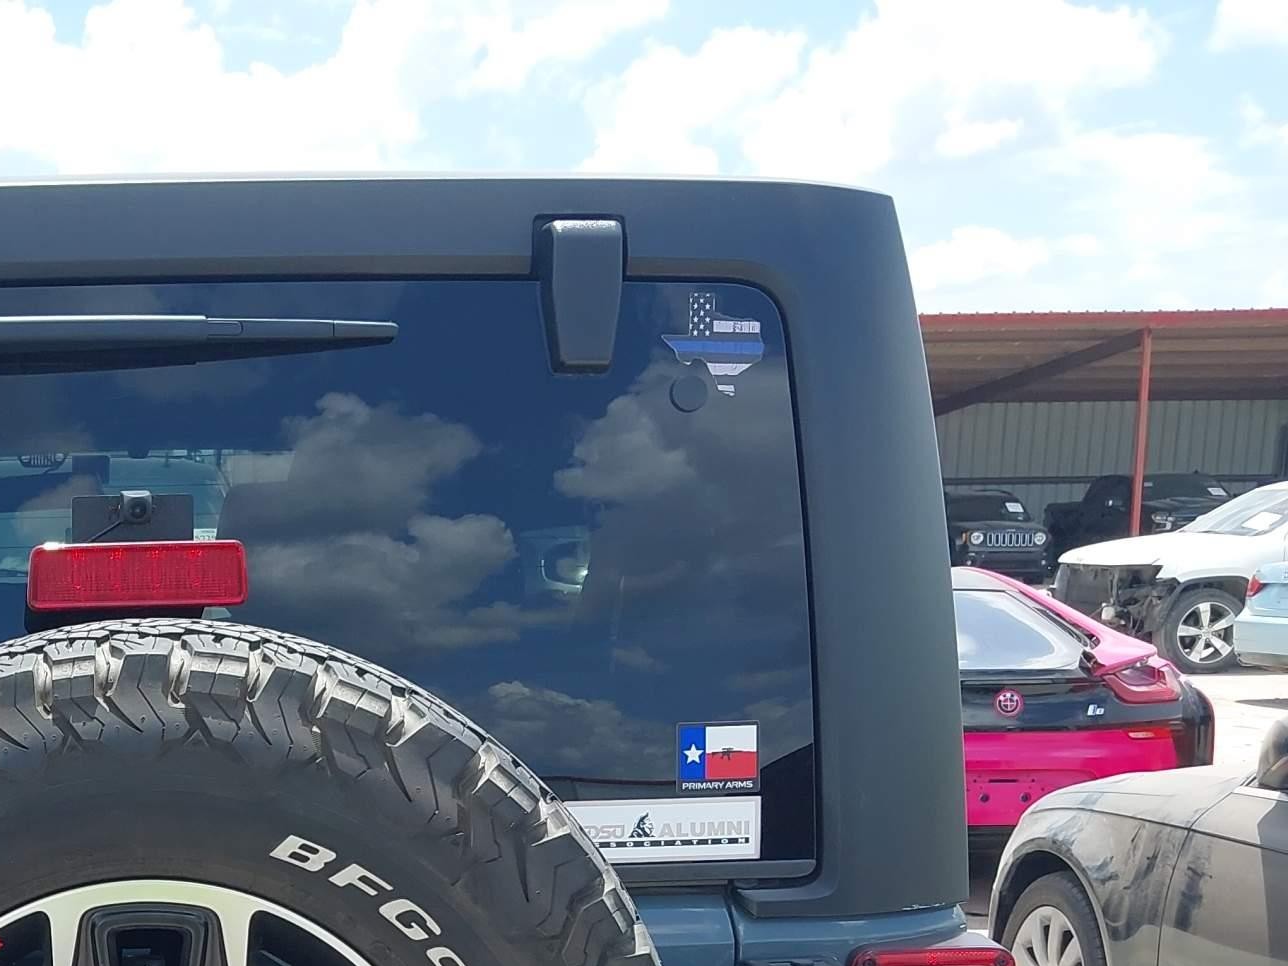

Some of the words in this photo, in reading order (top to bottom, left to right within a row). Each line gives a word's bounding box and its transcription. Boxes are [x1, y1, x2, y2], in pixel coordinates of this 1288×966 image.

[682, 781, 724, 790] PRIMARY
[725, 780, 754, 789] ARMS
[660, 820, 750, 838] ALUMNI
